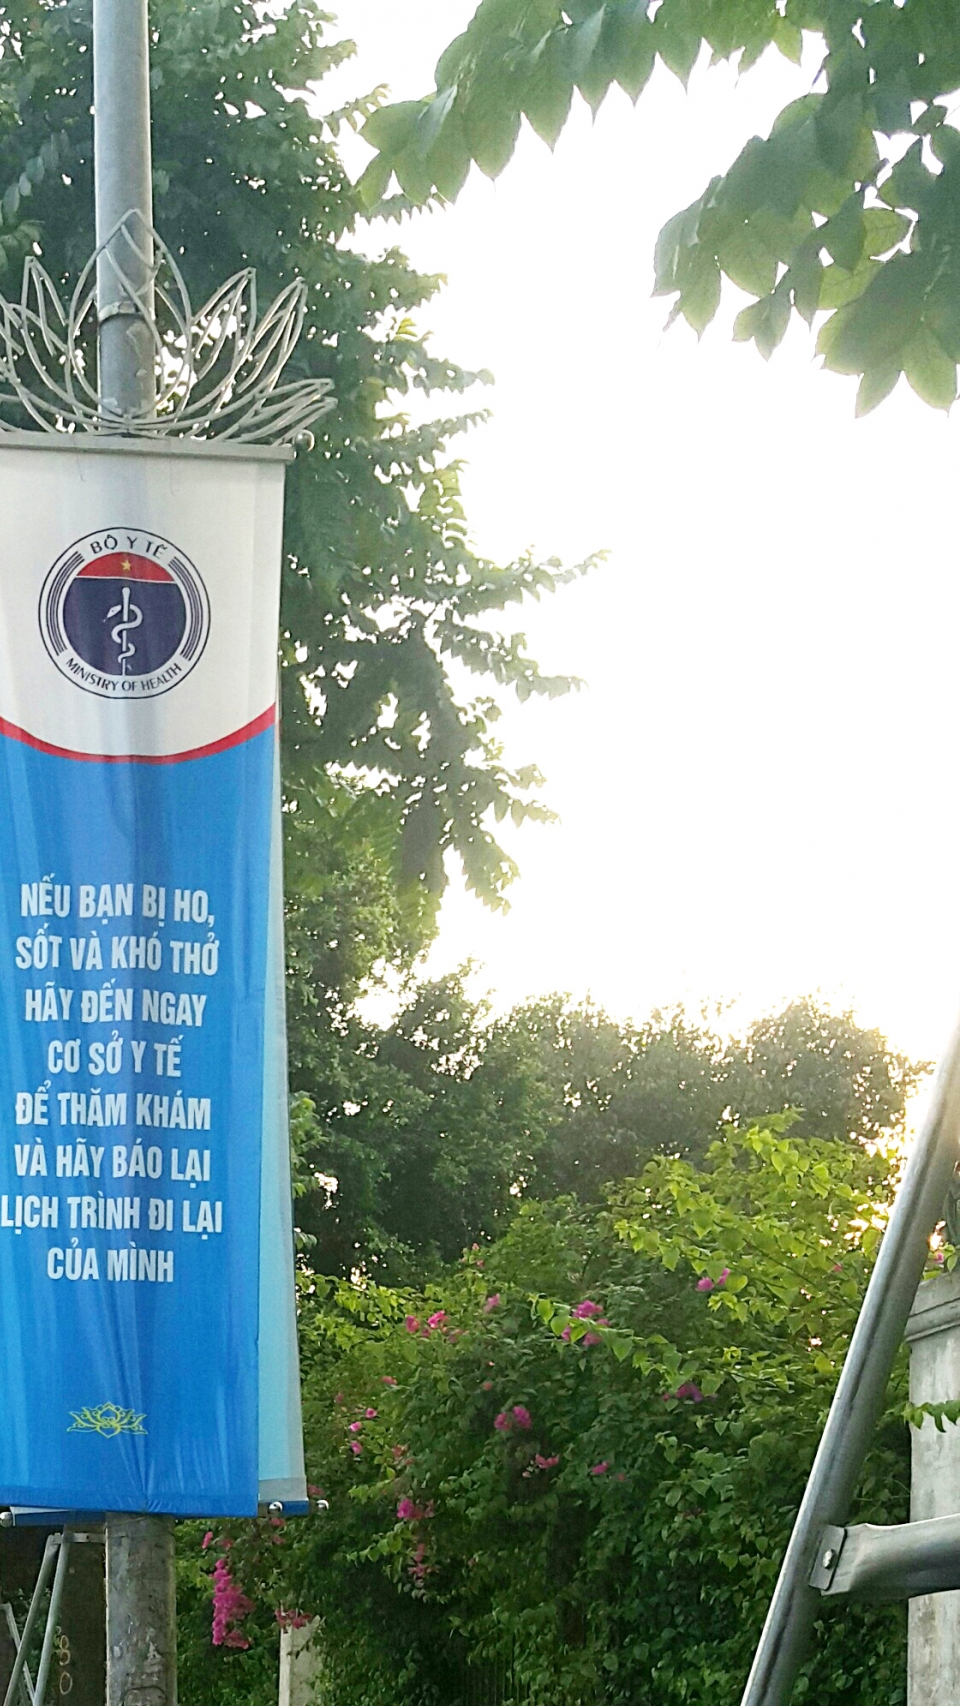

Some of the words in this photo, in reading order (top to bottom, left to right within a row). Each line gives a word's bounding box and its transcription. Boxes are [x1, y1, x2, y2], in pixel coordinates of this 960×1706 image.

[127, 536, 138, 549] Y
[66, 658, 119, 691] MINISTRY
[122, 680, 138, 691] OF
[141, 662, 183, 691] HEALTH
[21, 873, 71, 917] NẾU
[79, 883, 134, 925] BẠN
[142, 884, 166, 928] BỊ
[174, 889, 215, 928] HO,
[15, 923, 62, 970] SỐT
[70, 931, 103, 971] VÀ
[111, 931, 162, 970] KHÓ
[169, 932, 219, 976] THỞ
[25, 981, 73, 1022] HÃY
[81, 978, 133, 1023] ĐẾN
[142, 989, 207, 1027] NGAY
[47, 1038, 81, 1074] CƠ
[88, 1030, 123, 1076] SỞ
[131, 1040, 147, 1075] Y
[153, 1035, 184, 1078] TẾ
[15, 1080, 52, 1126] ĐỂ
[57, 1087, 127, 1127] THĂM
[136, 1090, 211, 1131] KHÁM
[14, 1137, 48, 1177] VÀ
[56, 1138, 105, 1178] HÃY
[112, 1138, 163, 1179] BÁO
[170, 1148, 211, 1189] LẠI
[0, 1195, 58, 1235] LỊCH
[66, 1190, 140, 1231] TRÌNH
[148, 1198, 174, 1232] ĐI
[182, 1201, 222, 1240] LẠI
[47, 1237, 99, 1281] CỦA
[107, 1241, 174, 1283] MÌNH
